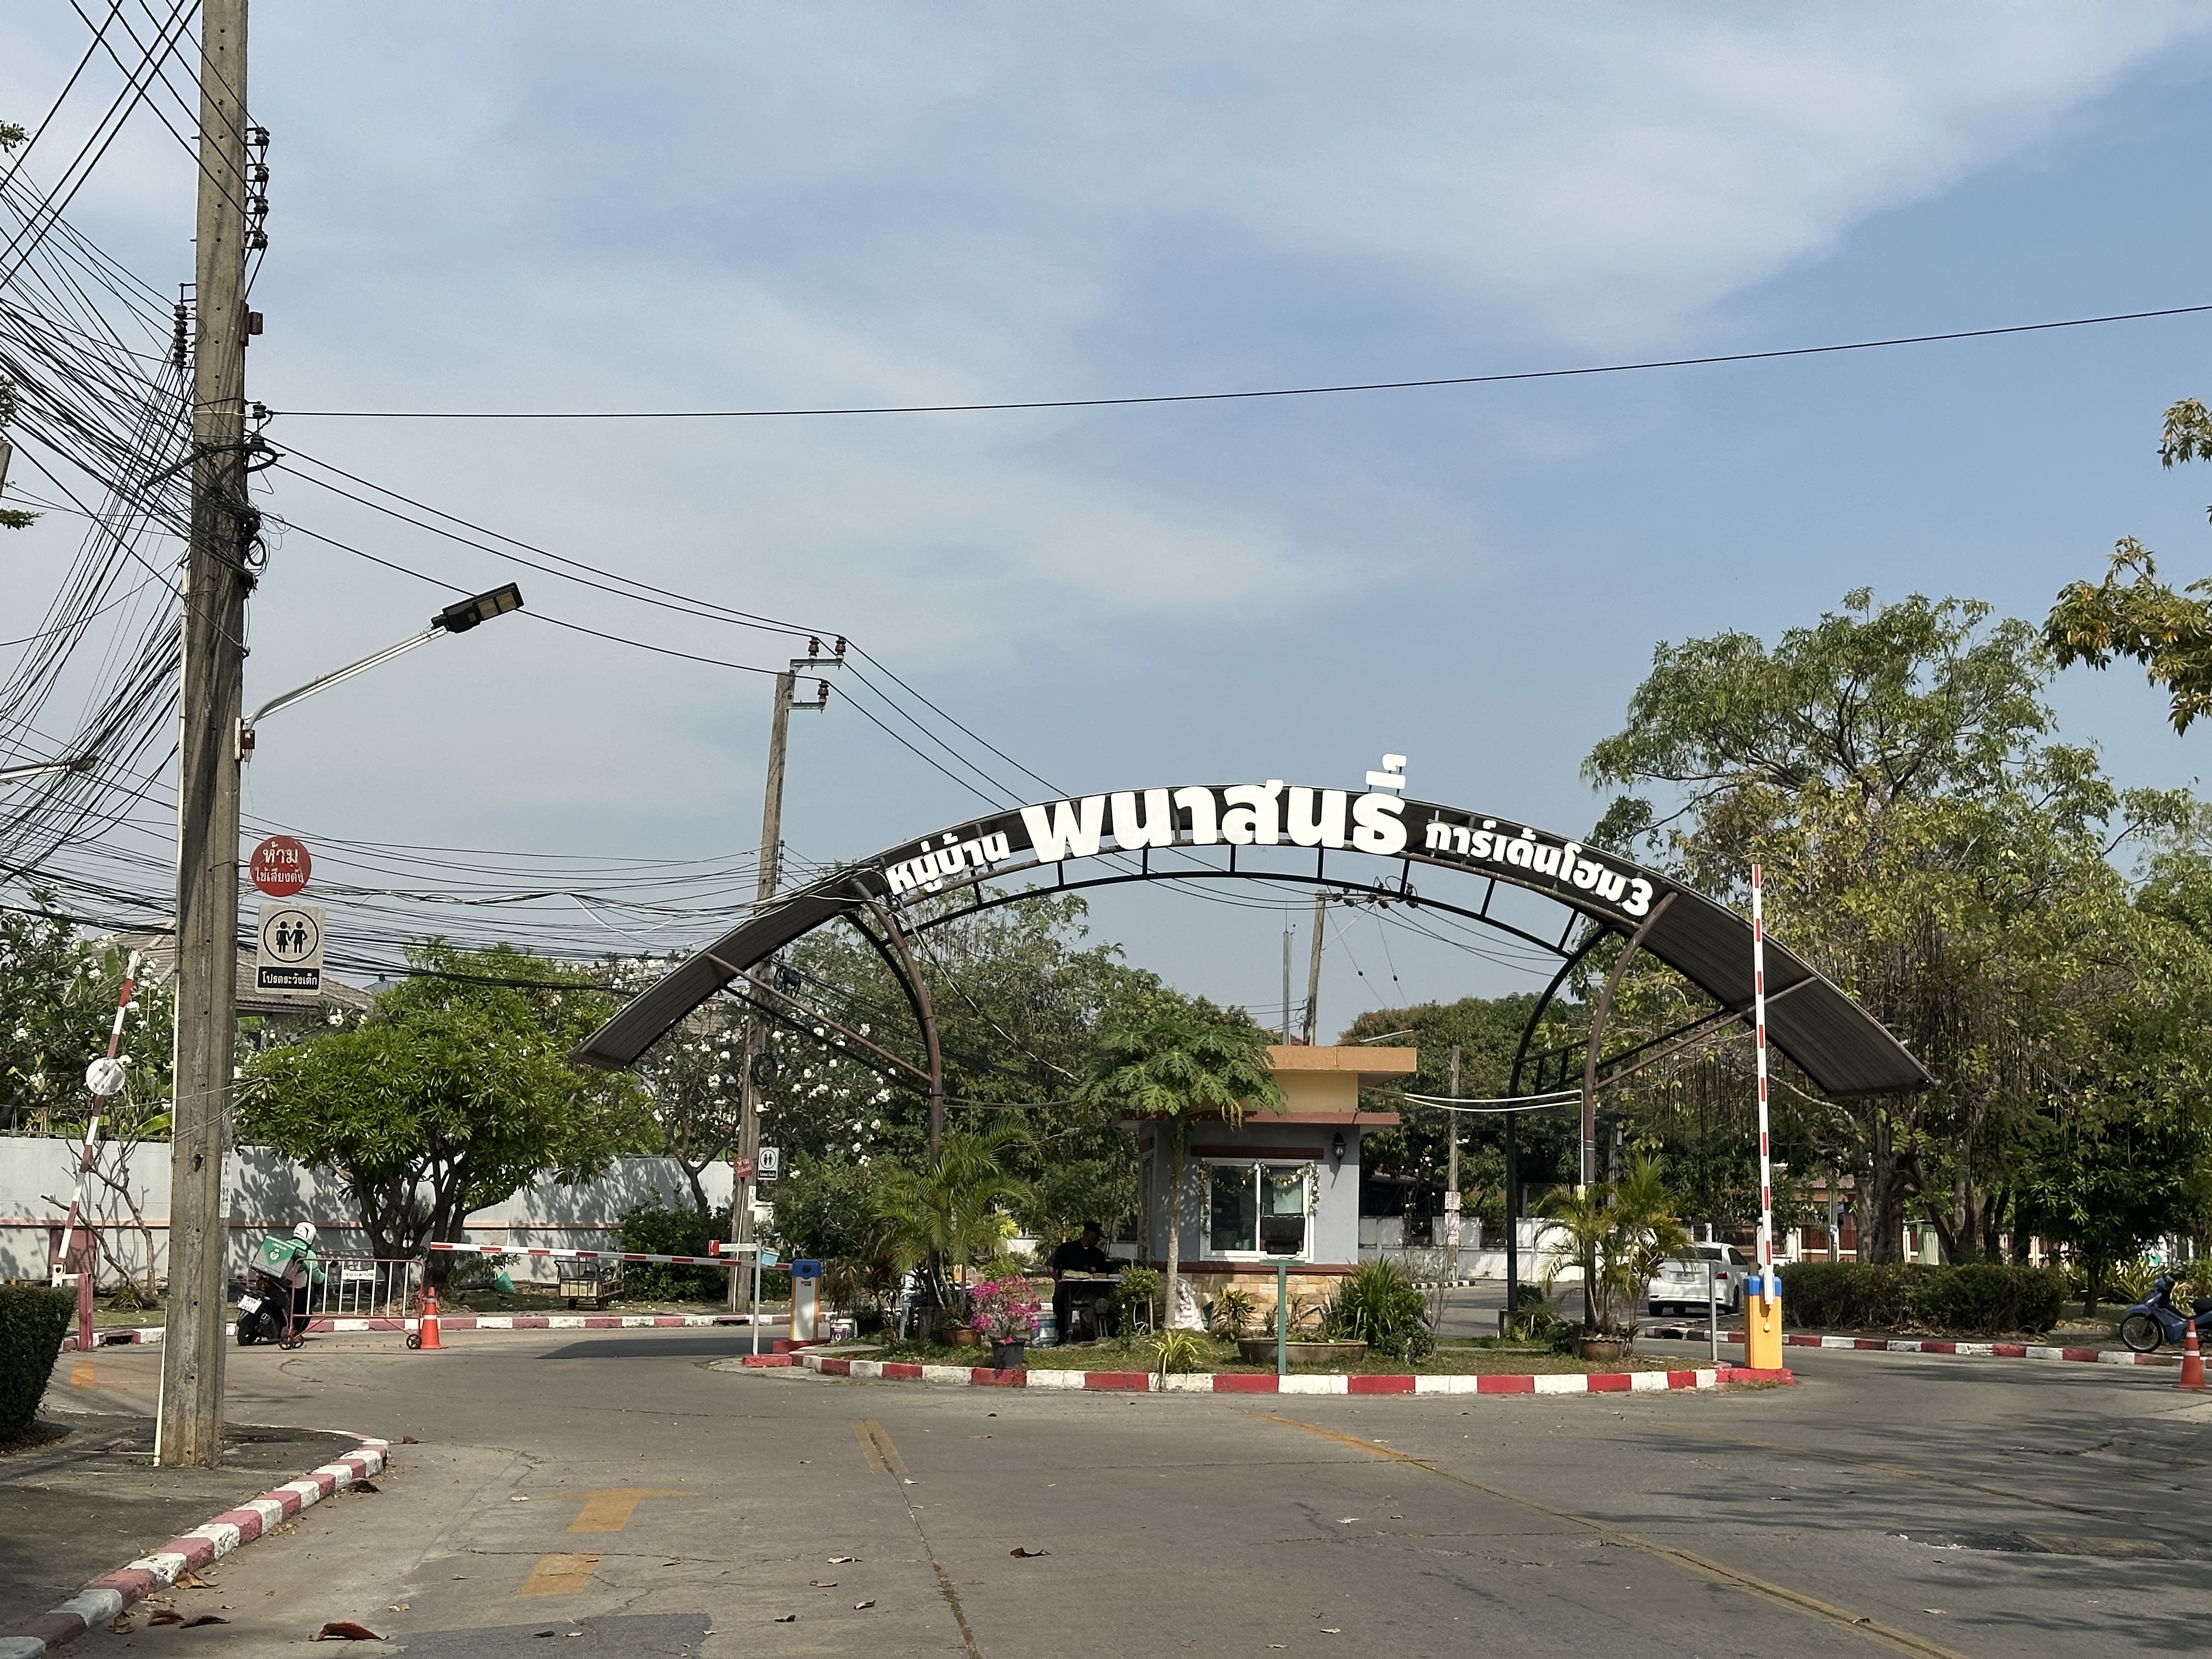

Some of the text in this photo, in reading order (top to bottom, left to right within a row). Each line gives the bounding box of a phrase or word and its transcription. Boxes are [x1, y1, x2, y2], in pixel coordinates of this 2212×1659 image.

[885, 833, 1008, 896] หมู่บ้าน
[1019, 753, 1407, 863] พนาสนธิ์
[263, 841, 298, 864] ห้าม
[262, 970, 317, 985] โปรดระวังเด็ก
